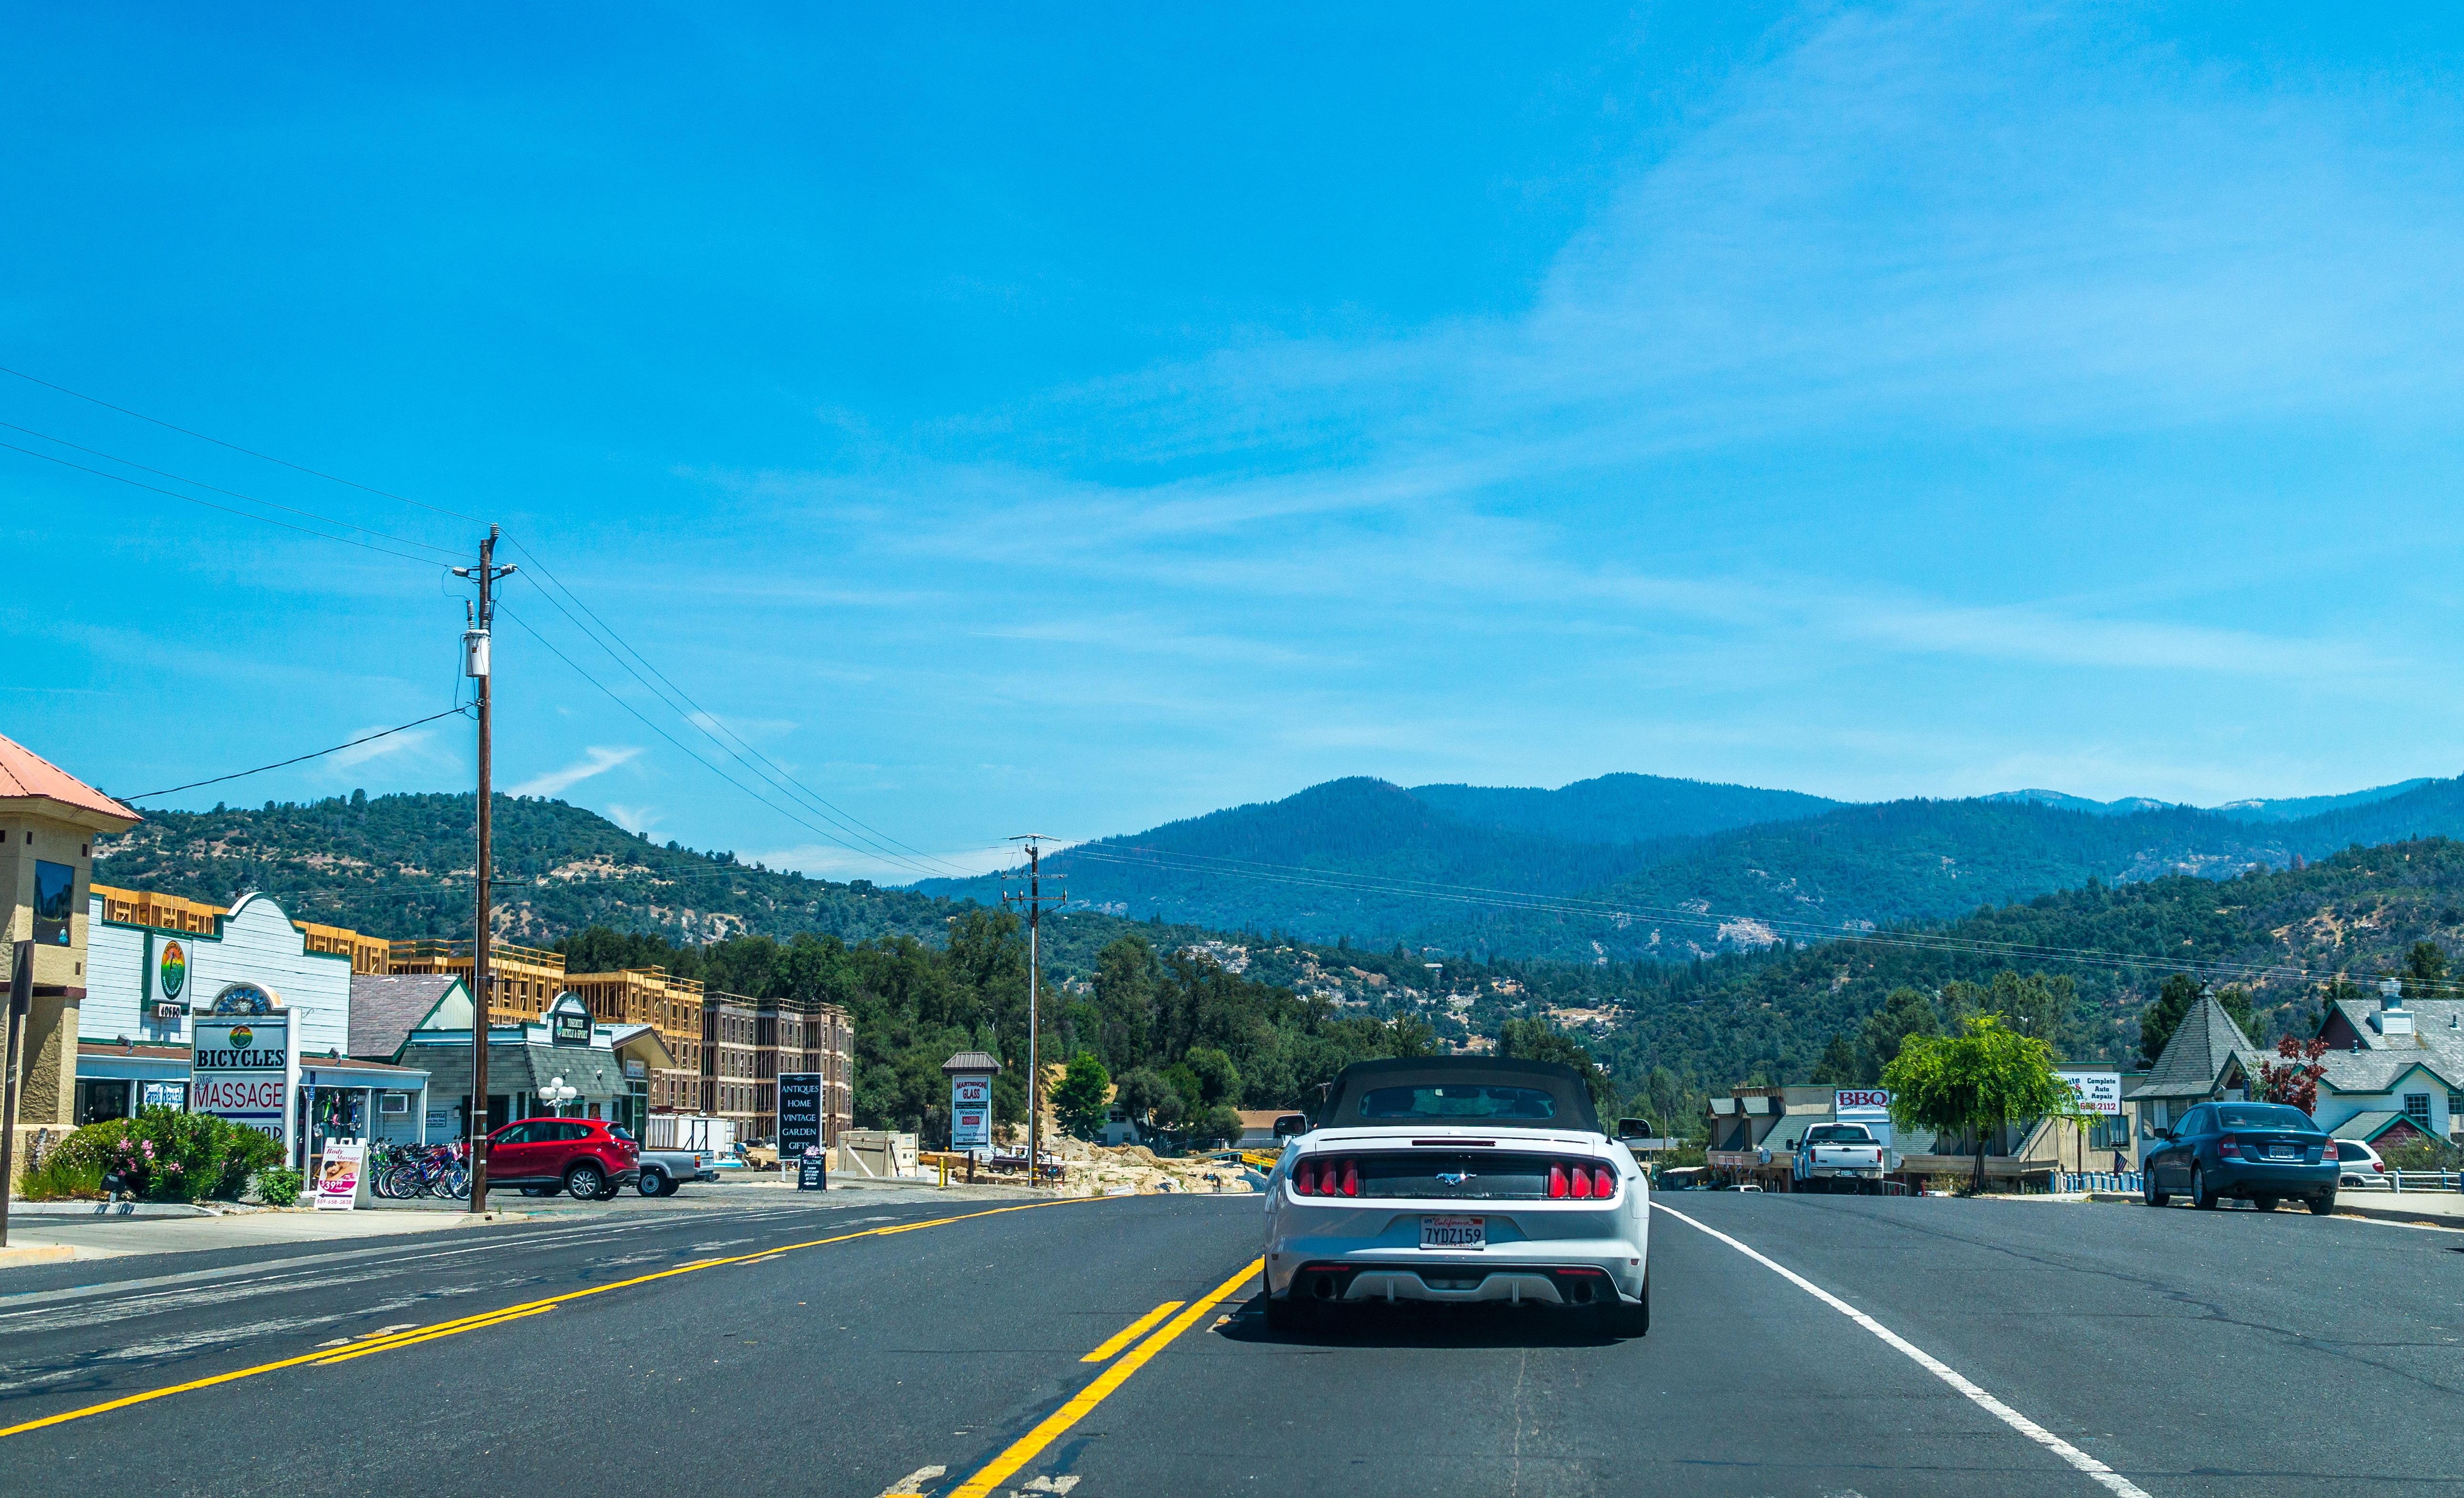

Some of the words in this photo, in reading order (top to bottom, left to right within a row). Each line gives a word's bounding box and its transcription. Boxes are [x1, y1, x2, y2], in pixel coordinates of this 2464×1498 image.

[196, 1050, 284, 1067] BICYCLES
[194, 1082, 284, 1108] MASSAGE
[781, 1085, 819, 1094] ANTIQUES
[963, 1089, 980, 1099] GLASS
[1838, 1091, 1887, 1107] BBQ
[1434, 1218, 1473, 1228] California
[1425, 1228, 1481, 1243] 7YDZ159
